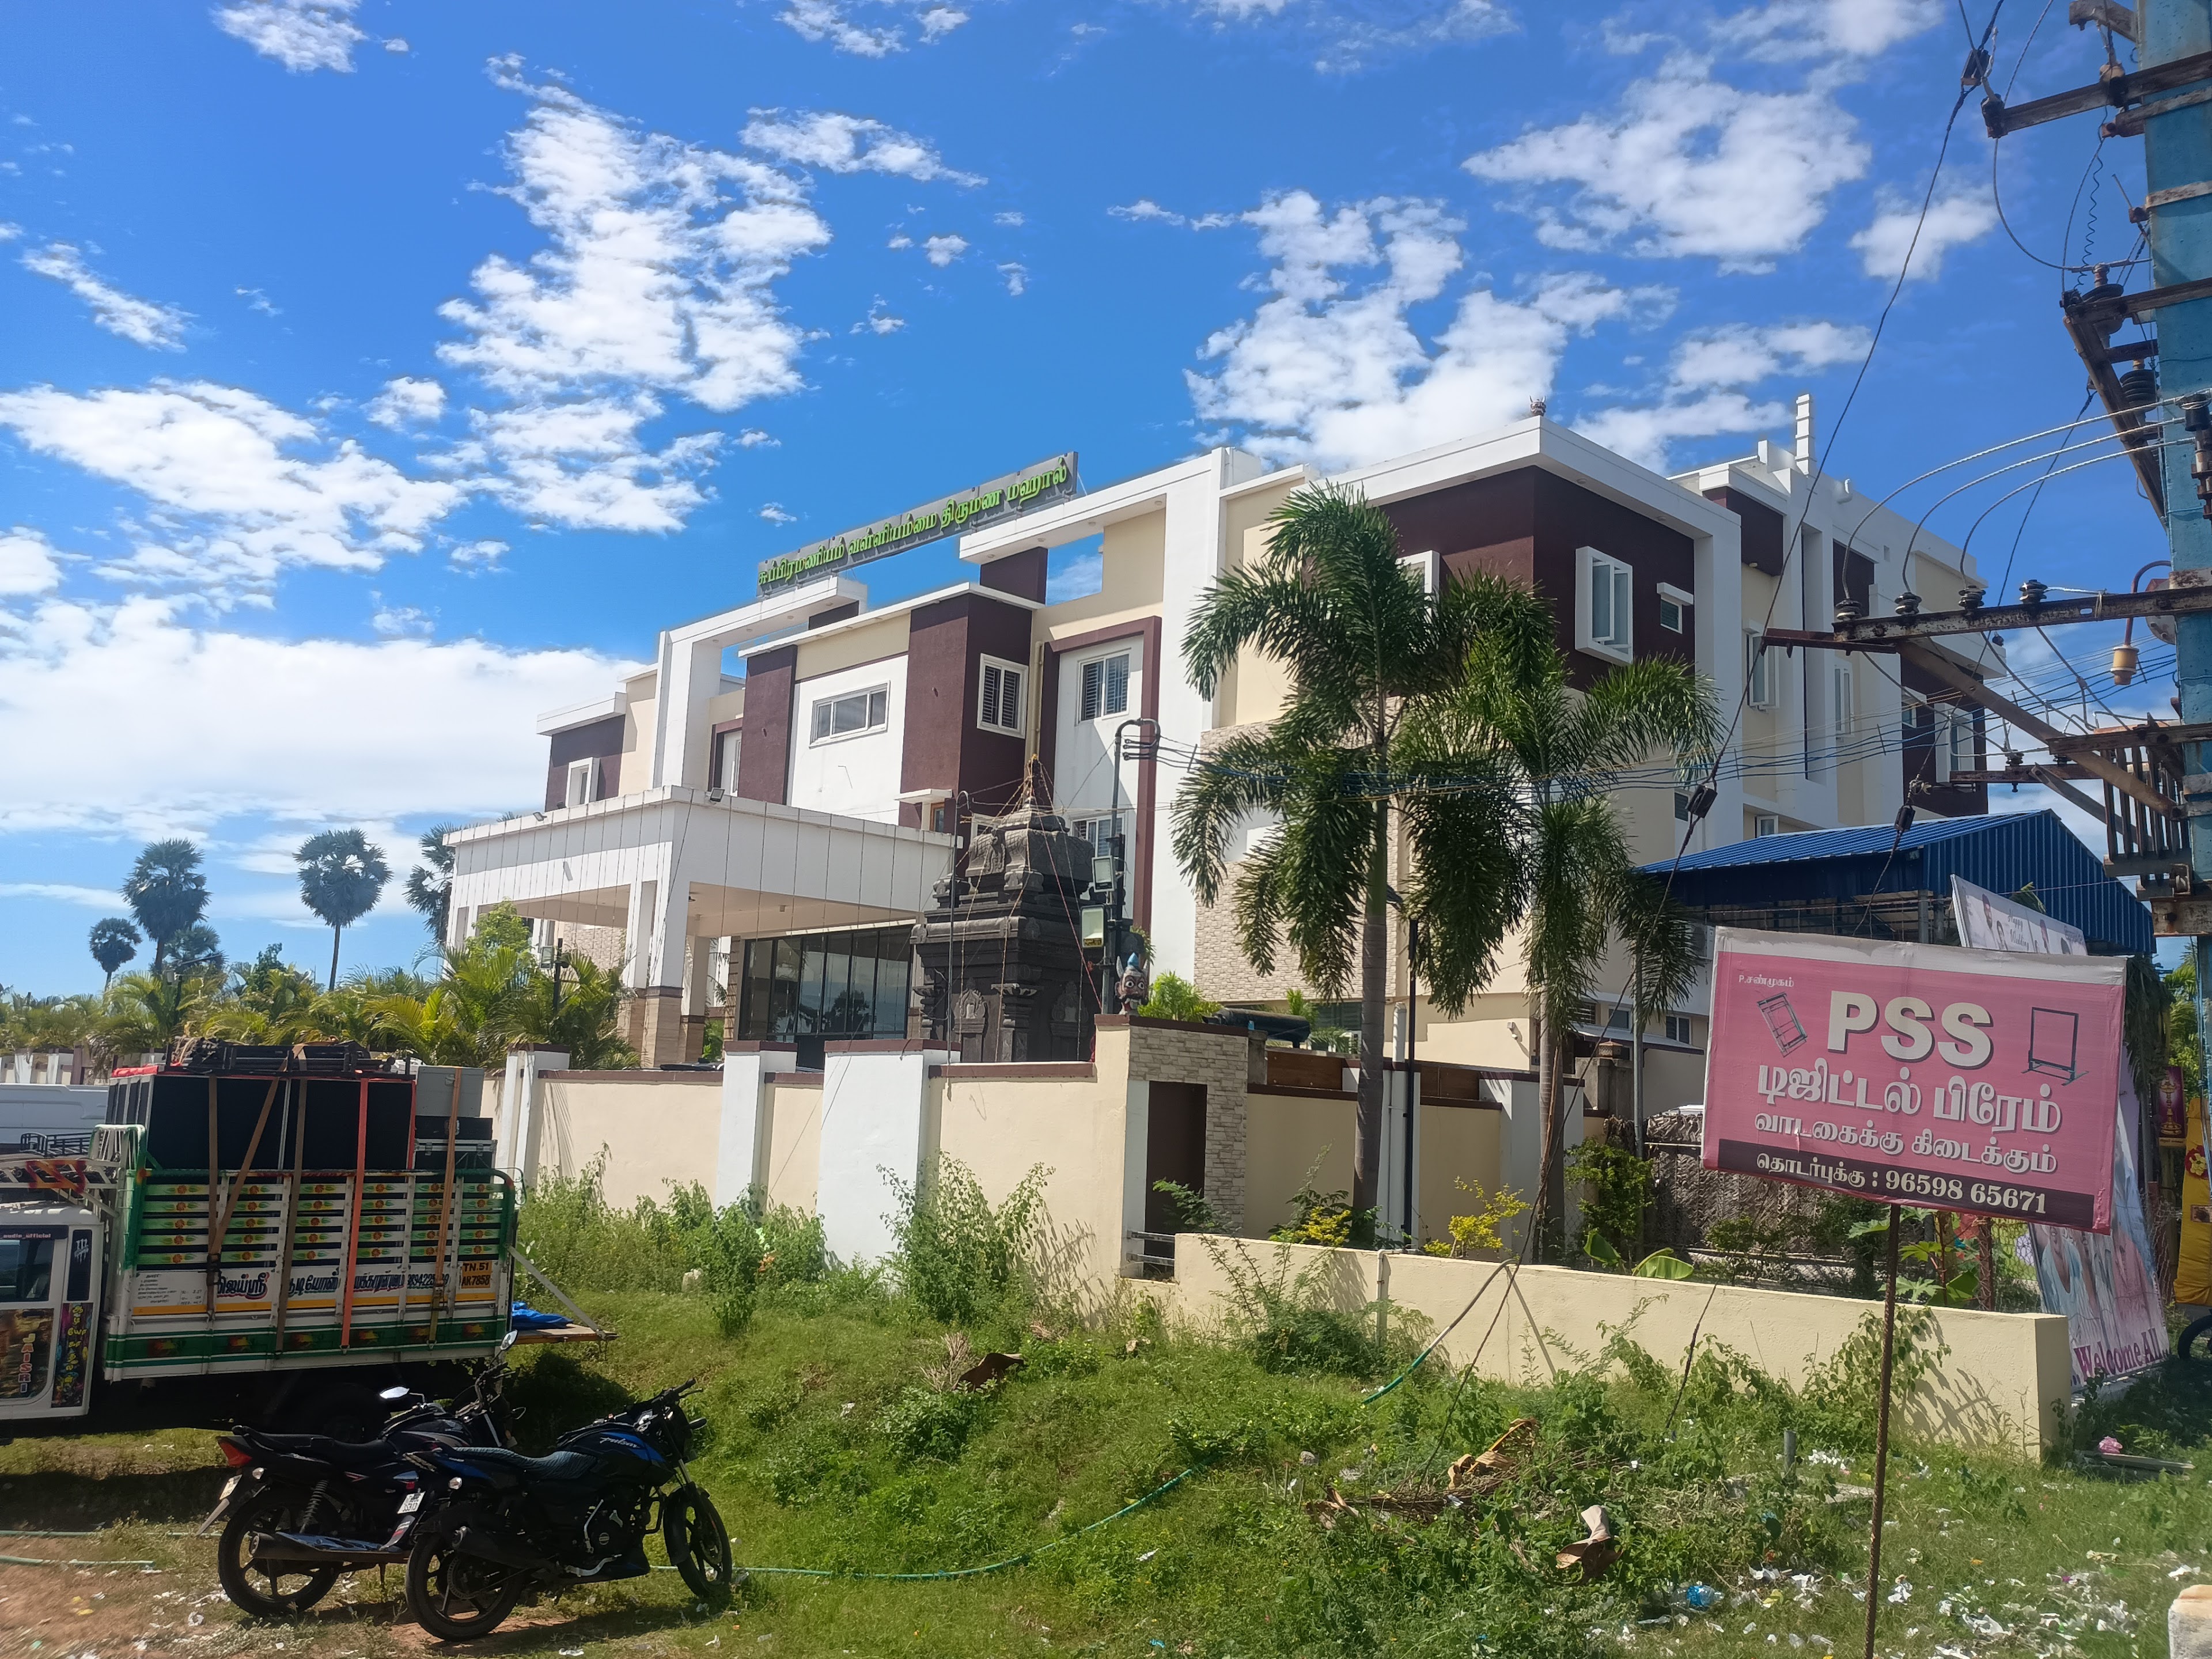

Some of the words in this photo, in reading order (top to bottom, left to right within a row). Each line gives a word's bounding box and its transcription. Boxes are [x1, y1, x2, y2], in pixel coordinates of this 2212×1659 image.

[758, 536, 844, 585] சுப்பிரமணியம்
[849, 513, 937, 553] வள்ளியம்மை
[941, 488, 1002, 527] திருமண
[1006, 457, 1067, 505] மஹால்
[1827, 991, 1993, 1069] PSS
[1757, 1057, 1922, 1115] டிஜிட்டல்
[1933, 1075, 2062, 1134] பிரேம்
[1755, 1112, 1904, 1155] வாடகைக்கு
[1911, 1128, 2058, 1174] கிடைக்கும்
[1756, 1153, 1866, 1188] தொடர்புக்கு
[1885, 1169, 1963, 1200] 96598
[1971, 1183, 2046, 1214] 65671
